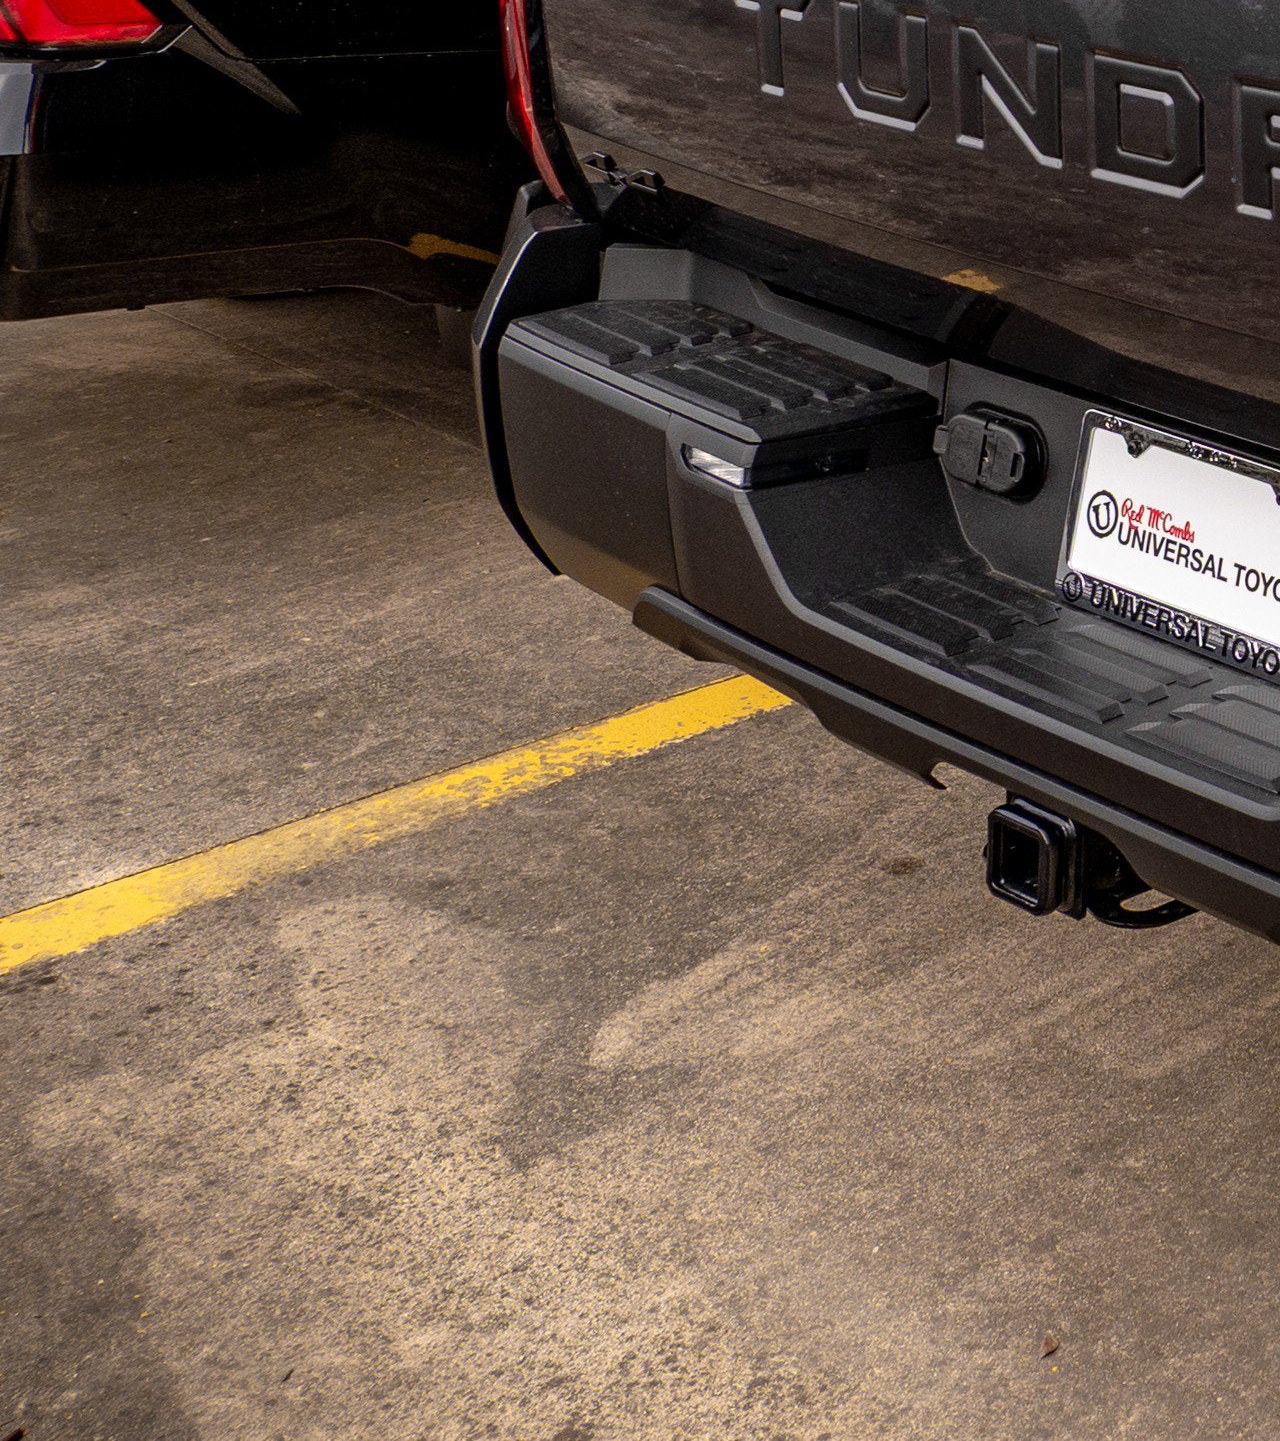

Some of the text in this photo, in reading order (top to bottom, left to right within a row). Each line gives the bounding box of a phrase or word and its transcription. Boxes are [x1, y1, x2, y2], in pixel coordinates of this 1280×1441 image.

[1121, 498, 1195, 543] Red McCombs
[1118, 522, 1228, 582] UNIVERSAL
[1090, 580, 1217, 651] UNIVERSAL
